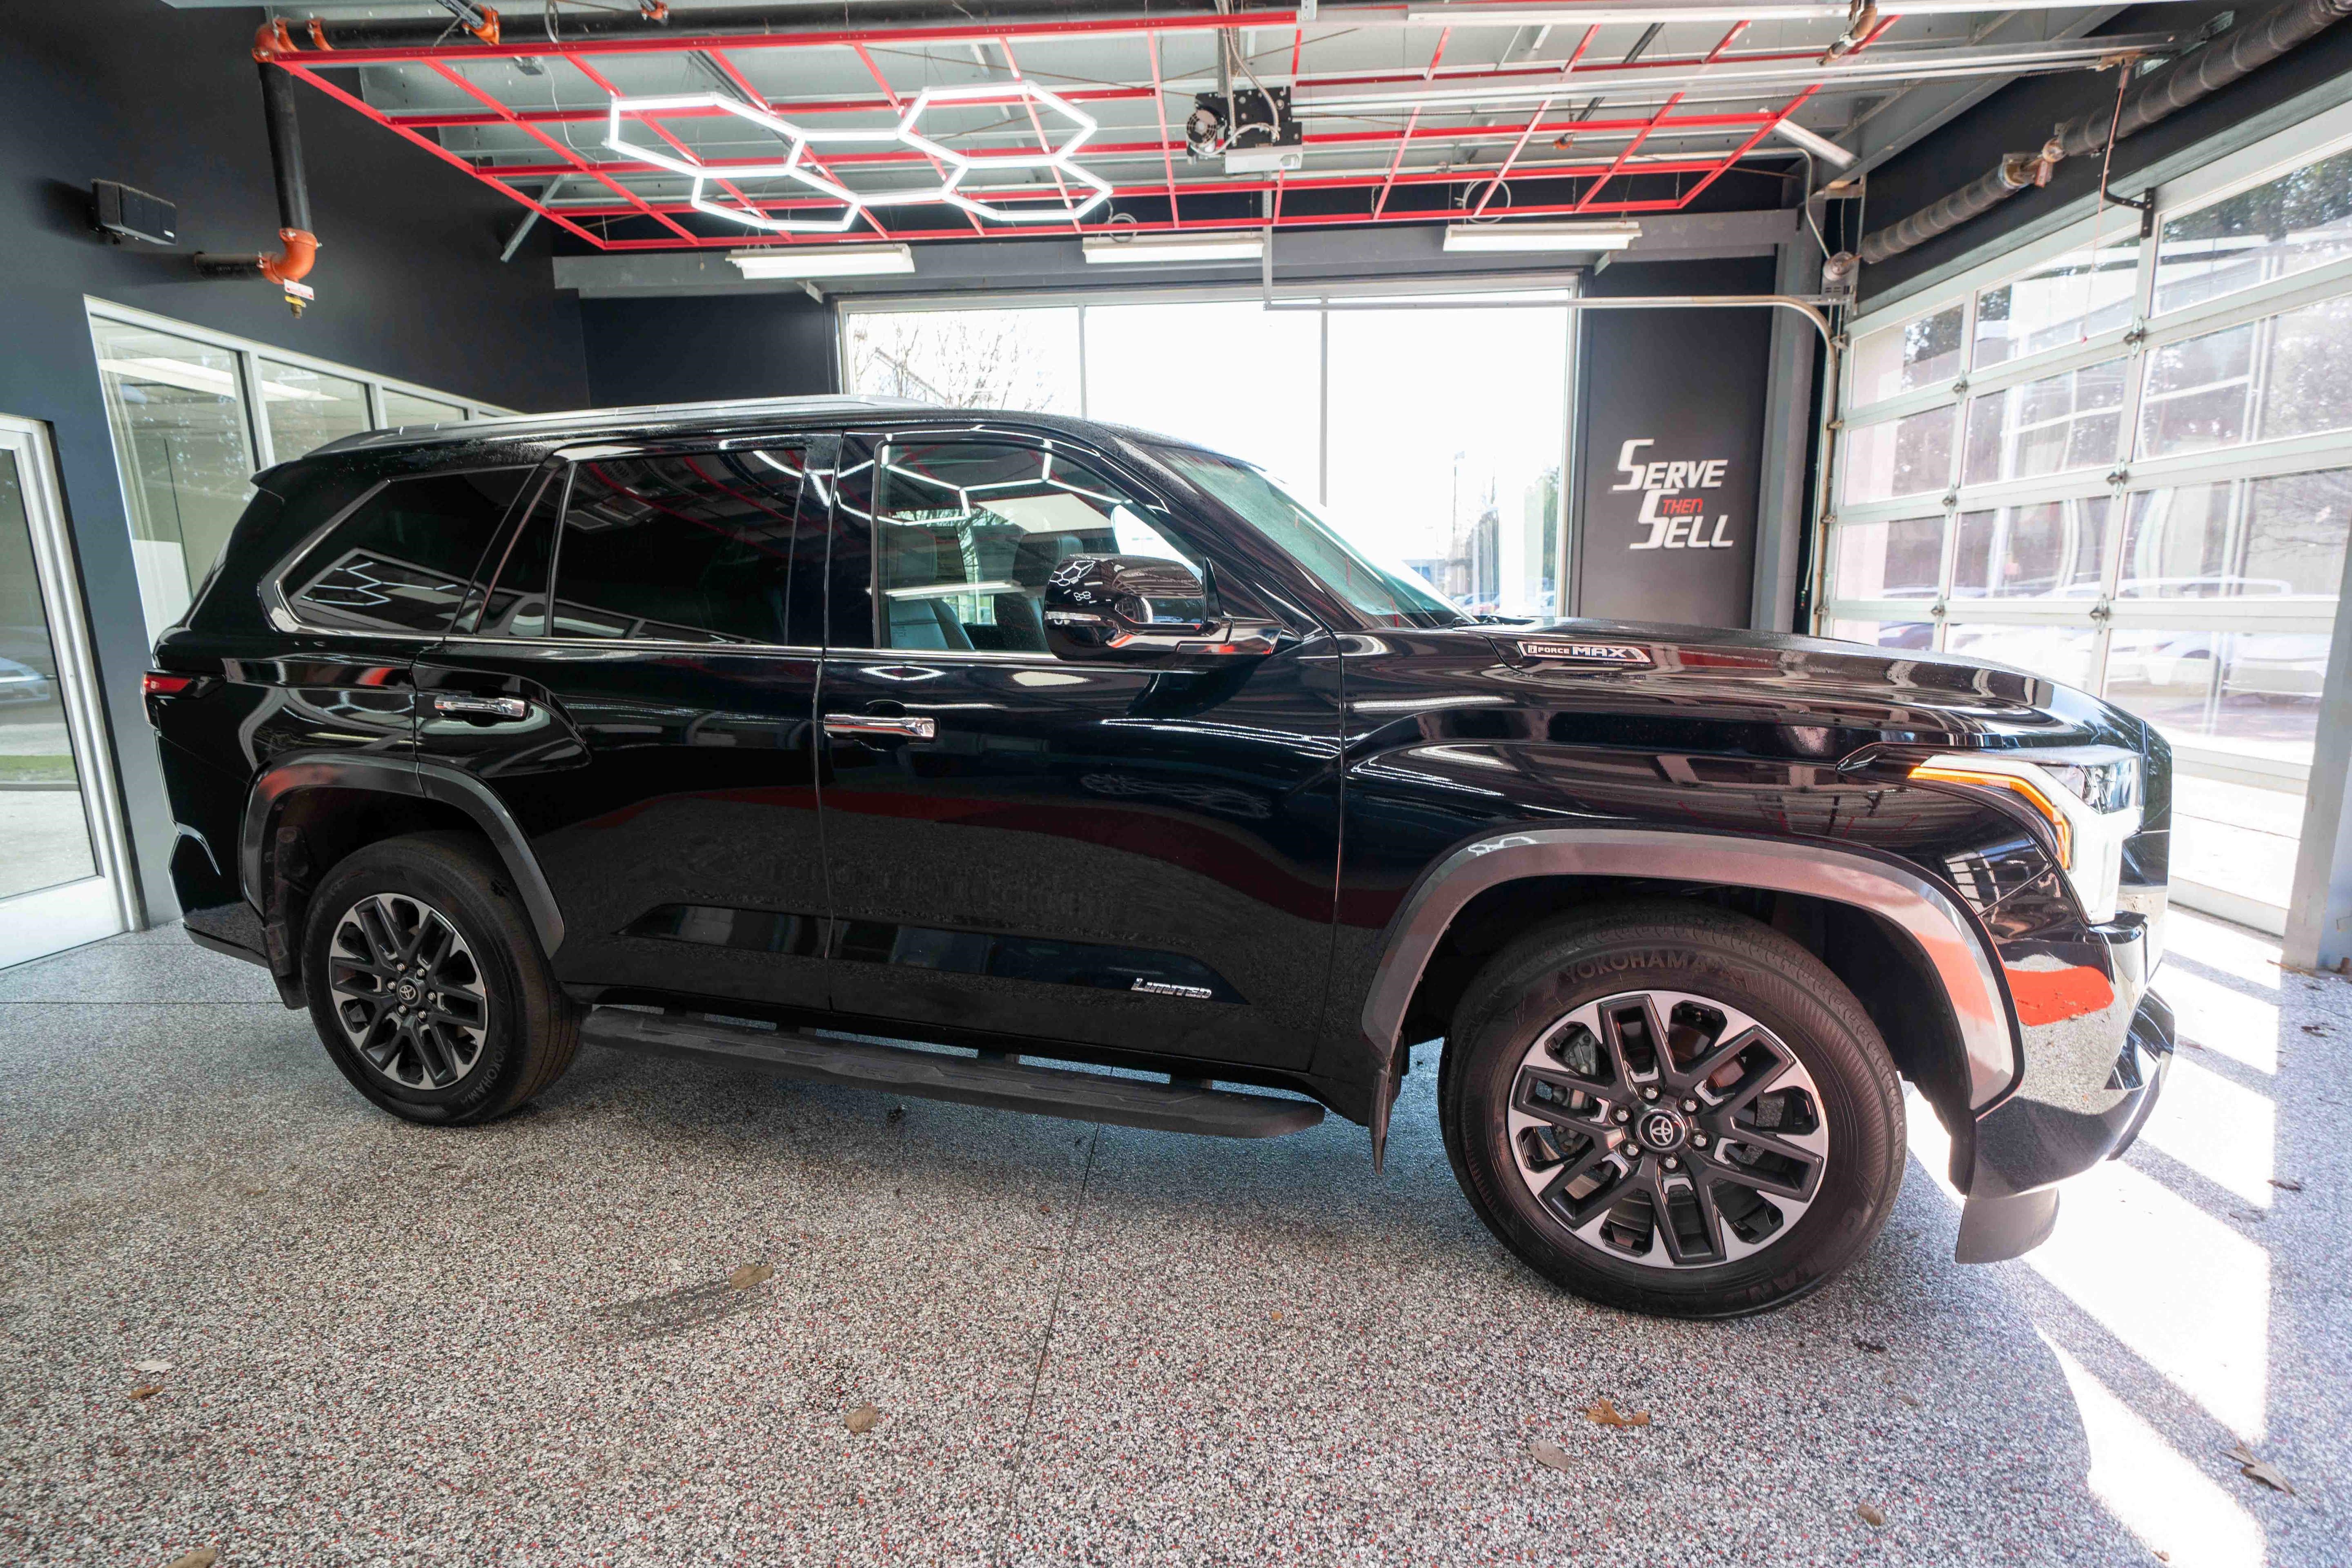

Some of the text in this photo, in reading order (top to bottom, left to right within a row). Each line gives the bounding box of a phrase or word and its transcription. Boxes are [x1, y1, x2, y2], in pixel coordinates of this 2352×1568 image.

[1613, 439, 1728, 491] SERVE
[1629, 488, 1734, 550] SELL
[1572, 646, 1627, 659] MAX
[1567, 949, 1707, 983] YOKOHAMA
